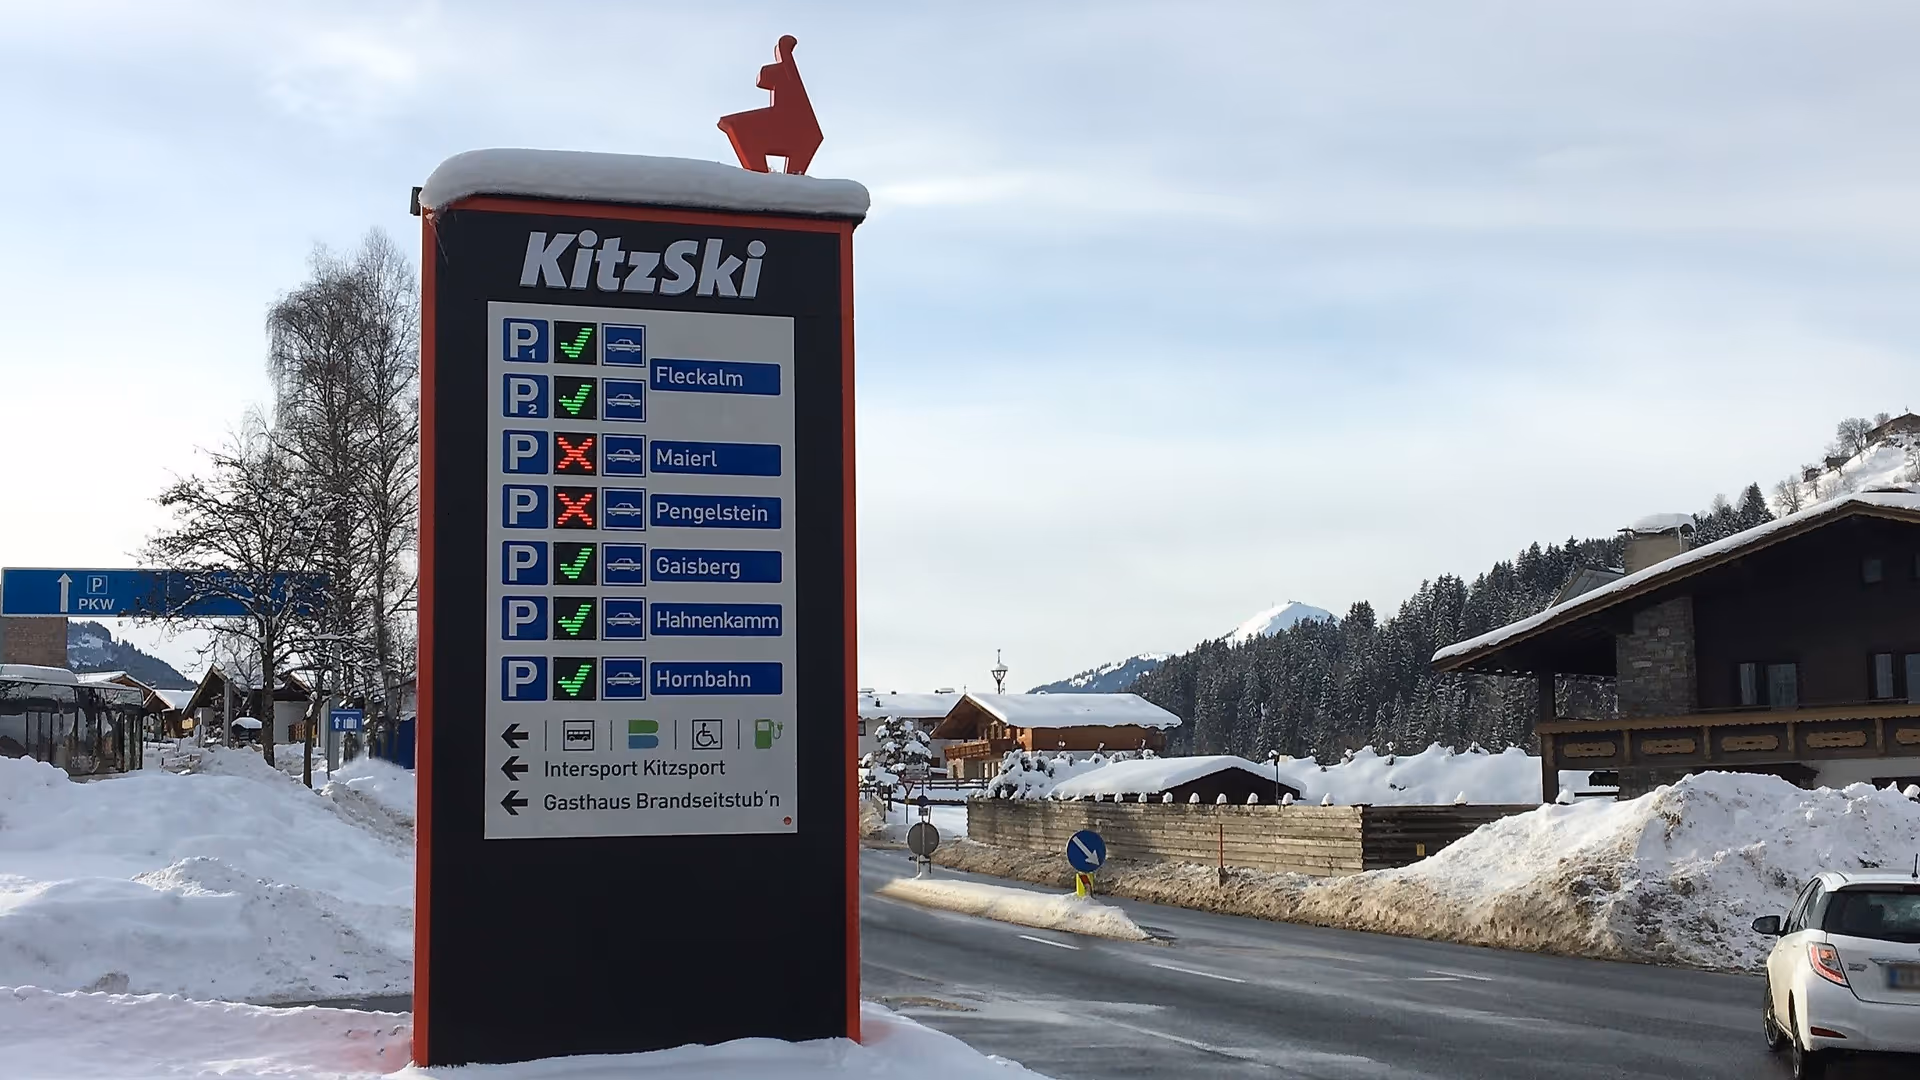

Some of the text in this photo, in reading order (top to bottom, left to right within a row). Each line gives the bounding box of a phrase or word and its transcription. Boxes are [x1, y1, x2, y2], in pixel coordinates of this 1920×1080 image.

[519, 229, 767, 299] KitzSki
[656, 366, 744, 387] Fleckalm
[509, 434, 539, 470] P
[656, 448, 717, 467] Maierl
[508, 488, 538, 525] P
[656, 502, 769, 524] Pengelstein
[508, 545, 538, 581] P
[656, 557, 741, 579] Gaisberg
[78, 598, 115, 611] PKW
[508, 600, 538, 637] P
[656, 611, 779, 629] Hahnenkamm
[508, 660, 538, 697] P
[656, 669, 752, 688] Hornbahn
[544, 759, 726, 780] Intersport Kitzsport
[543, 793, 631, 811] Gasthaus
